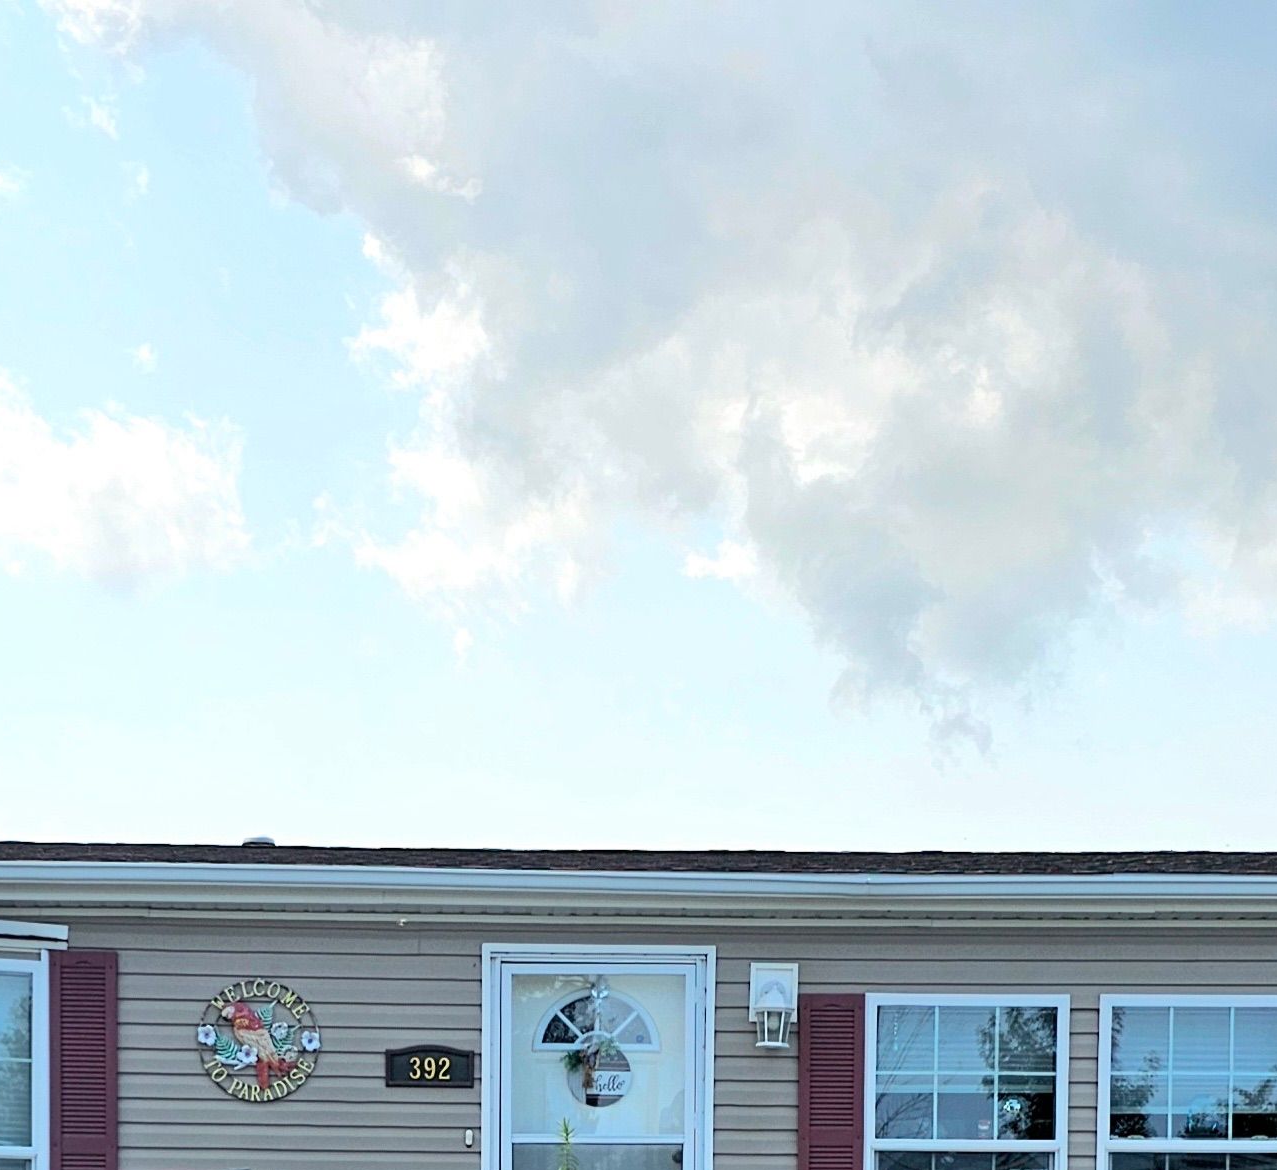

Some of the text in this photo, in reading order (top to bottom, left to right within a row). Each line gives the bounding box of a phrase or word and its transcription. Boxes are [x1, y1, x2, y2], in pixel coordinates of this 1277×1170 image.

[211, 978, 311, 1019] WELCOME
[204, 1058, 315, 1102] TO PARADISE
[409, 1056, 450, 1080] 392
[595, 1074, 625, 1092] hello
